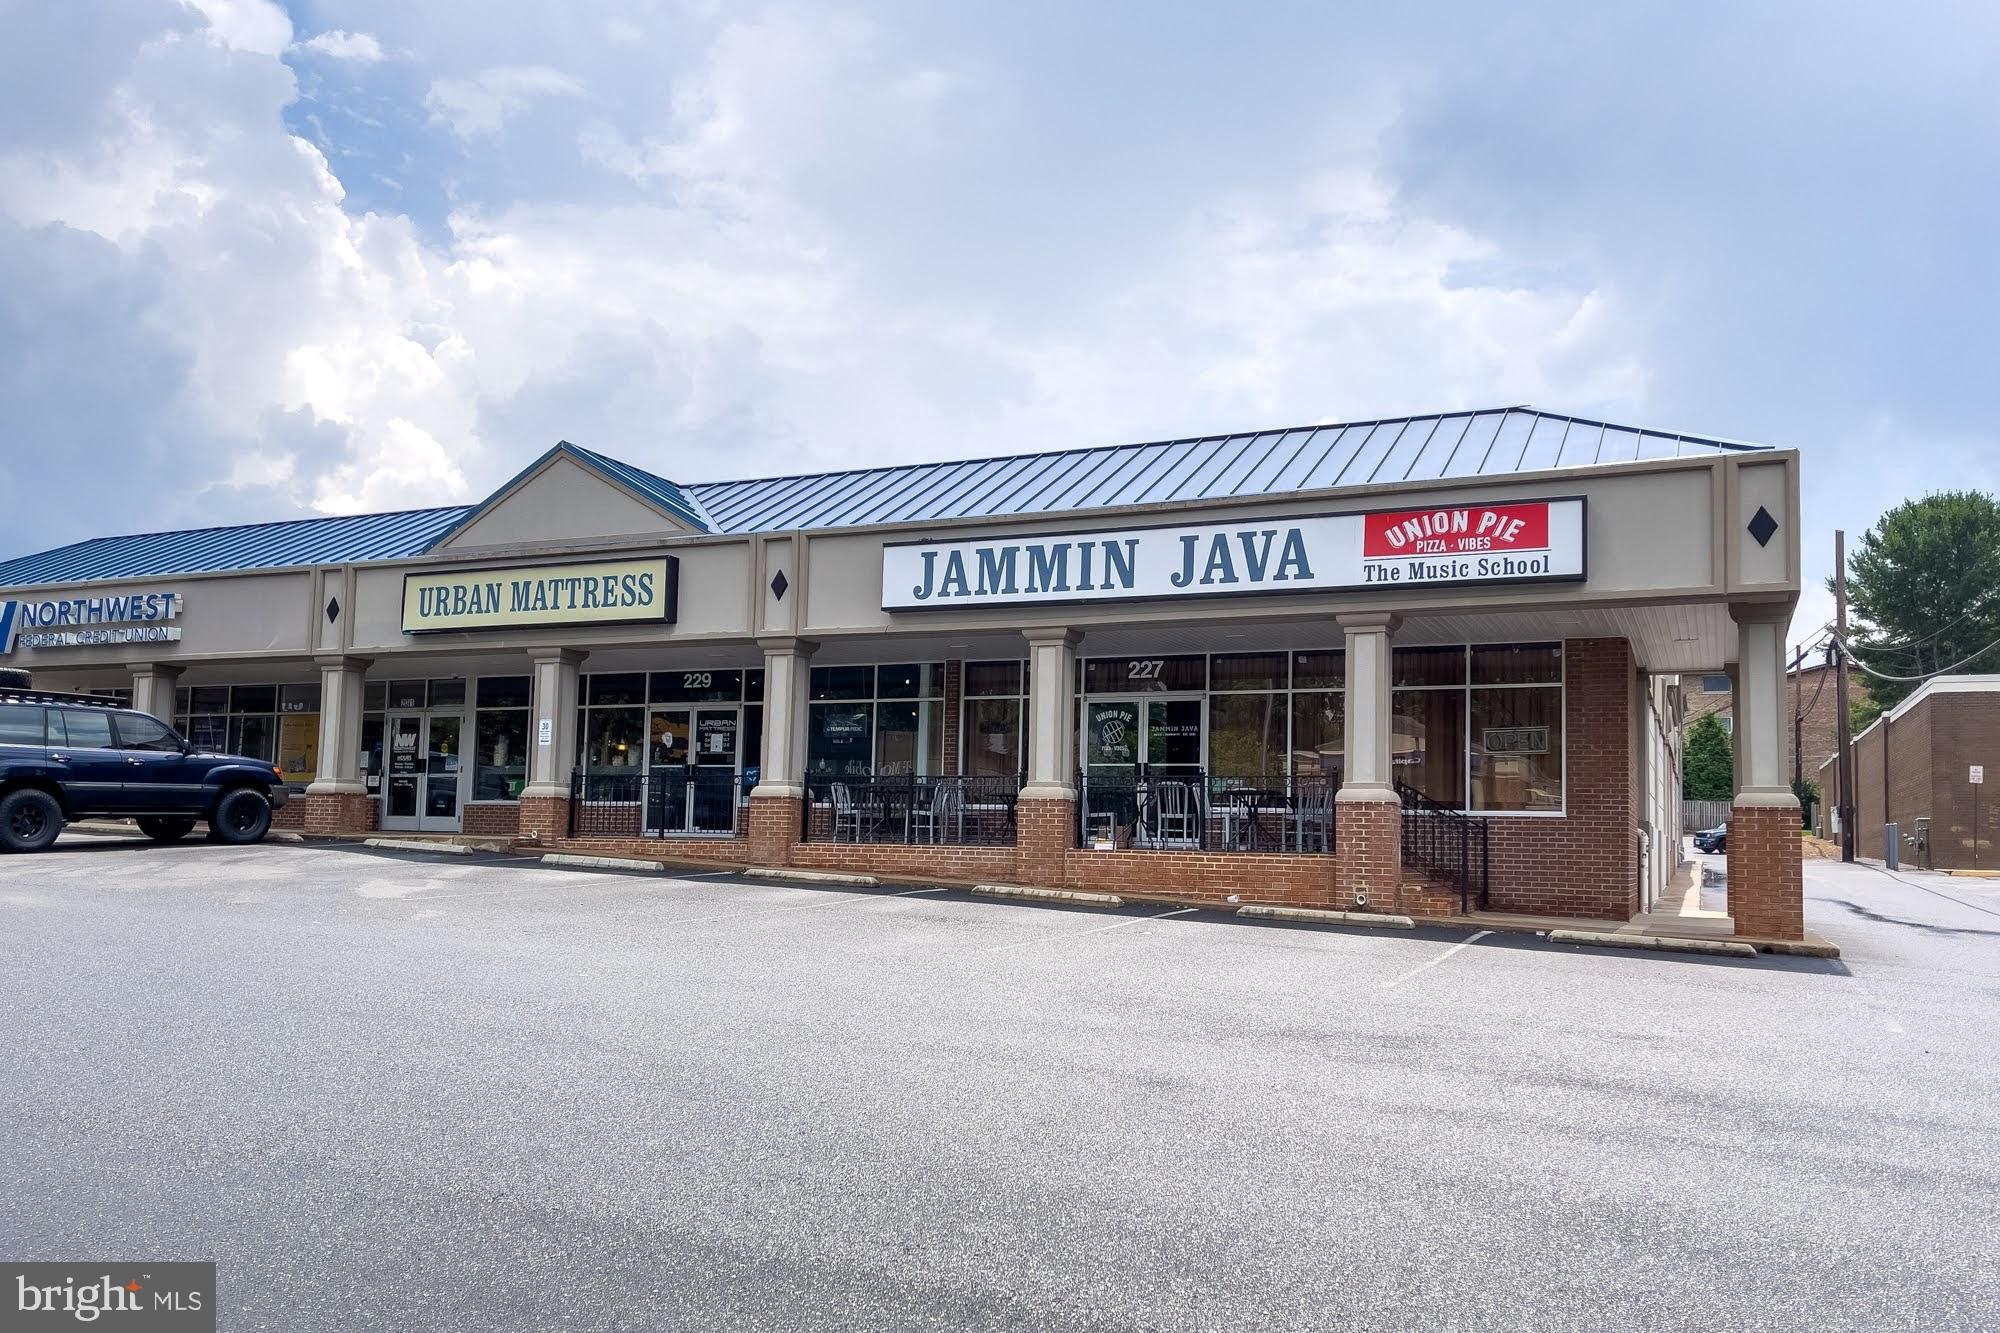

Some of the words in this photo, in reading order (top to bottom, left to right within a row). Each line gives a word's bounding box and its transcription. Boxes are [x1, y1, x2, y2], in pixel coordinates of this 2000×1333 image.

[1384, 510, 1469, 548] UNION
[1475, 511, 1525, 543] PIE
[1416, 538, 1447, 553] PIZZA
[1457, 536, 1491, 551] VIBES
[913, 538, 1140, 600] JAMMIN
[1170, 527, 1314, 588] JAVA
[1363, 564, 1400, 582] The
[1408, 560, 1469, 580] Music
[1477, 555, 1550, 577] School
[418, 582, 503, 618] URBAN
[510, 573, 654, 613] MATTRESS
[21, 593, 175, 627] NORTHWEST
[19, 632, 72, 647] FEDERAL
[75, 629, 120, 645] CREDIT
[125, 626, 169, 642] UNION
[1128, 660, 1164, 679] 227
[683, 672, 712, 688] 229
[700, 719, 736, 727] URBAN
[1095, 710, 1118, 721] UNION
[1119, 711, 1132, 722] PIE
[1486, 731, 1546, 751] OPEN
